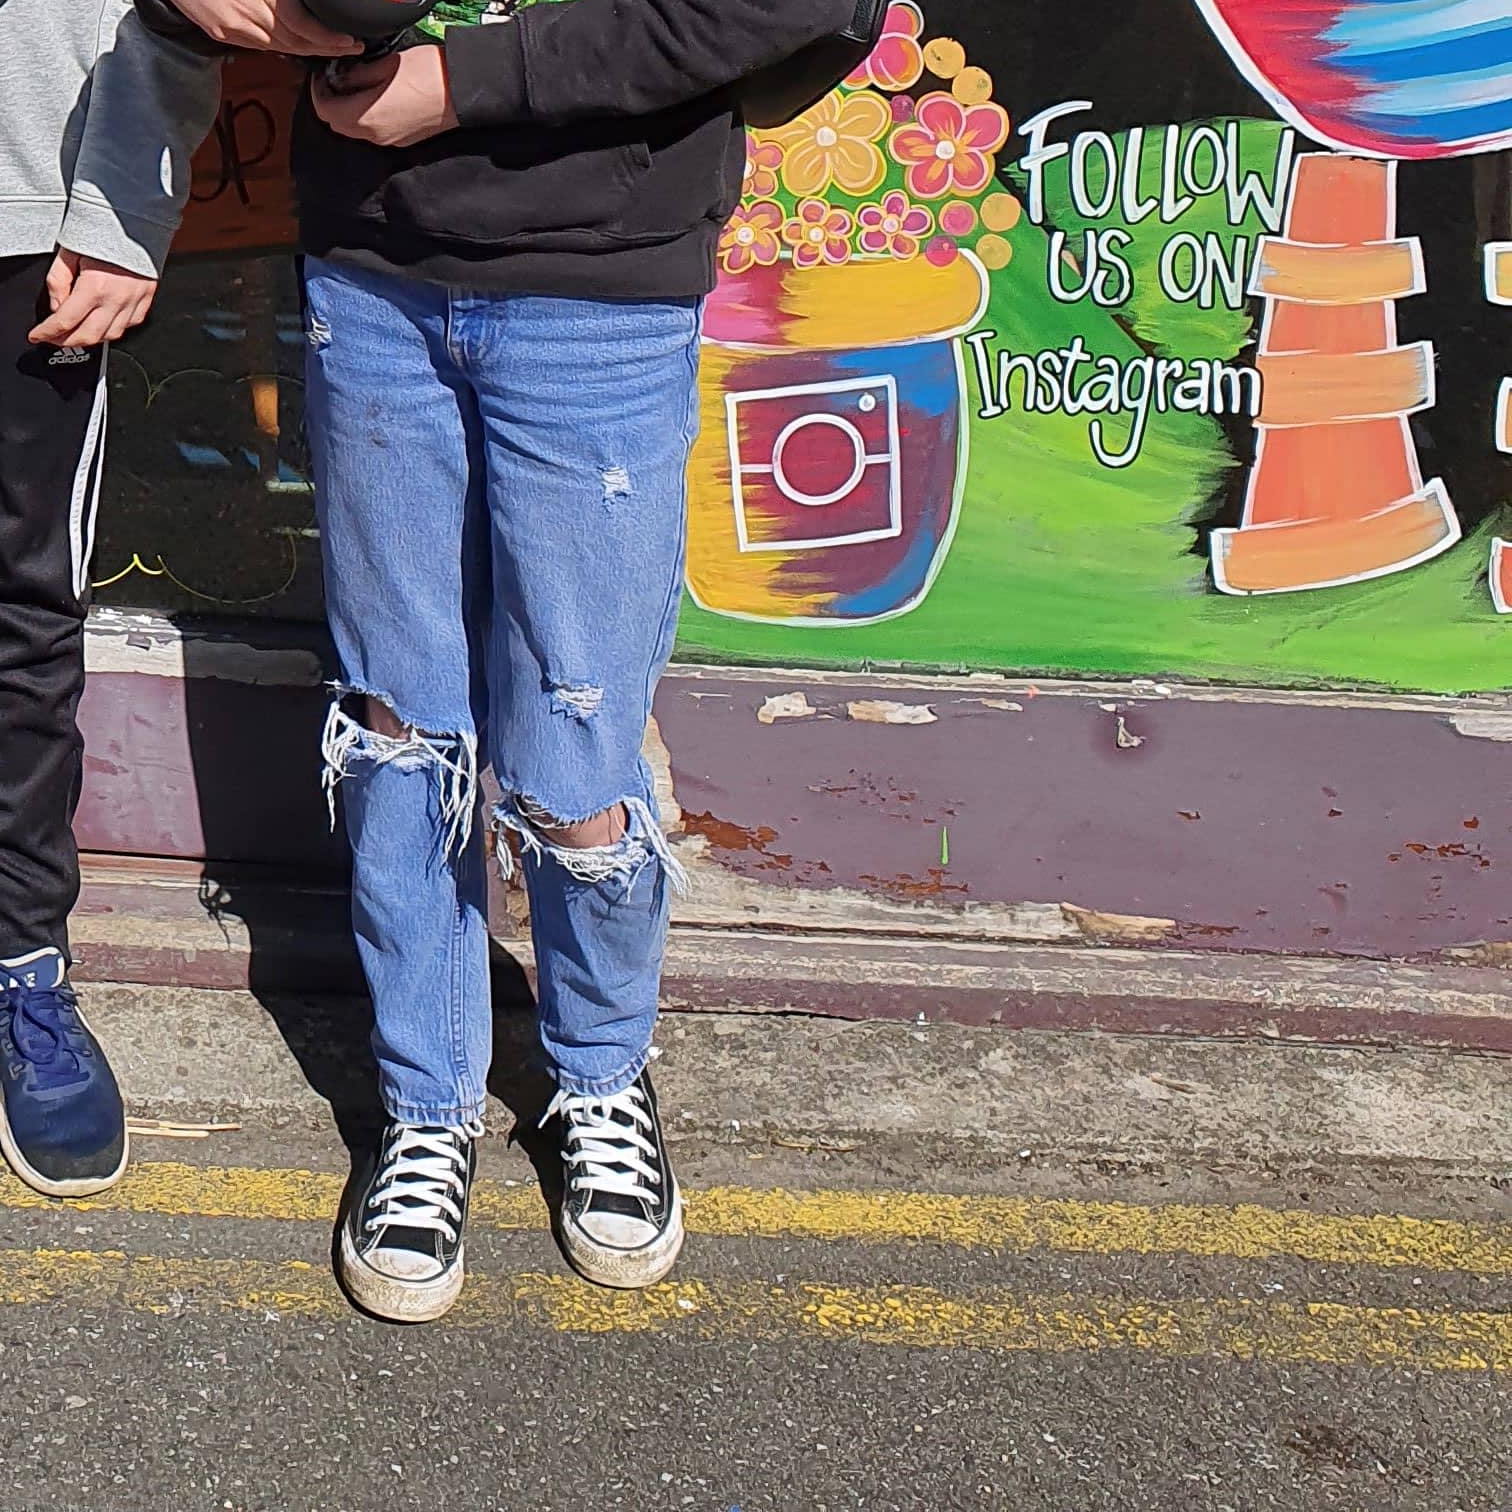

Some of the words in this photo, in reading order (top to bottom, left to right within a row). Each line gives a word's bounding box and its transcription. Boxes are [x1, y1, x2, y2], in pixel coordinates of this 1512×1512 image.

[1017, 100, 1296, 232] FOLLOW
[1046, 229, 1133, 306] US
[1159, 232, 1248, 310] ON
[48, 353, 90, 365] adidas
[965, 331, 1262, 469] Instagram
